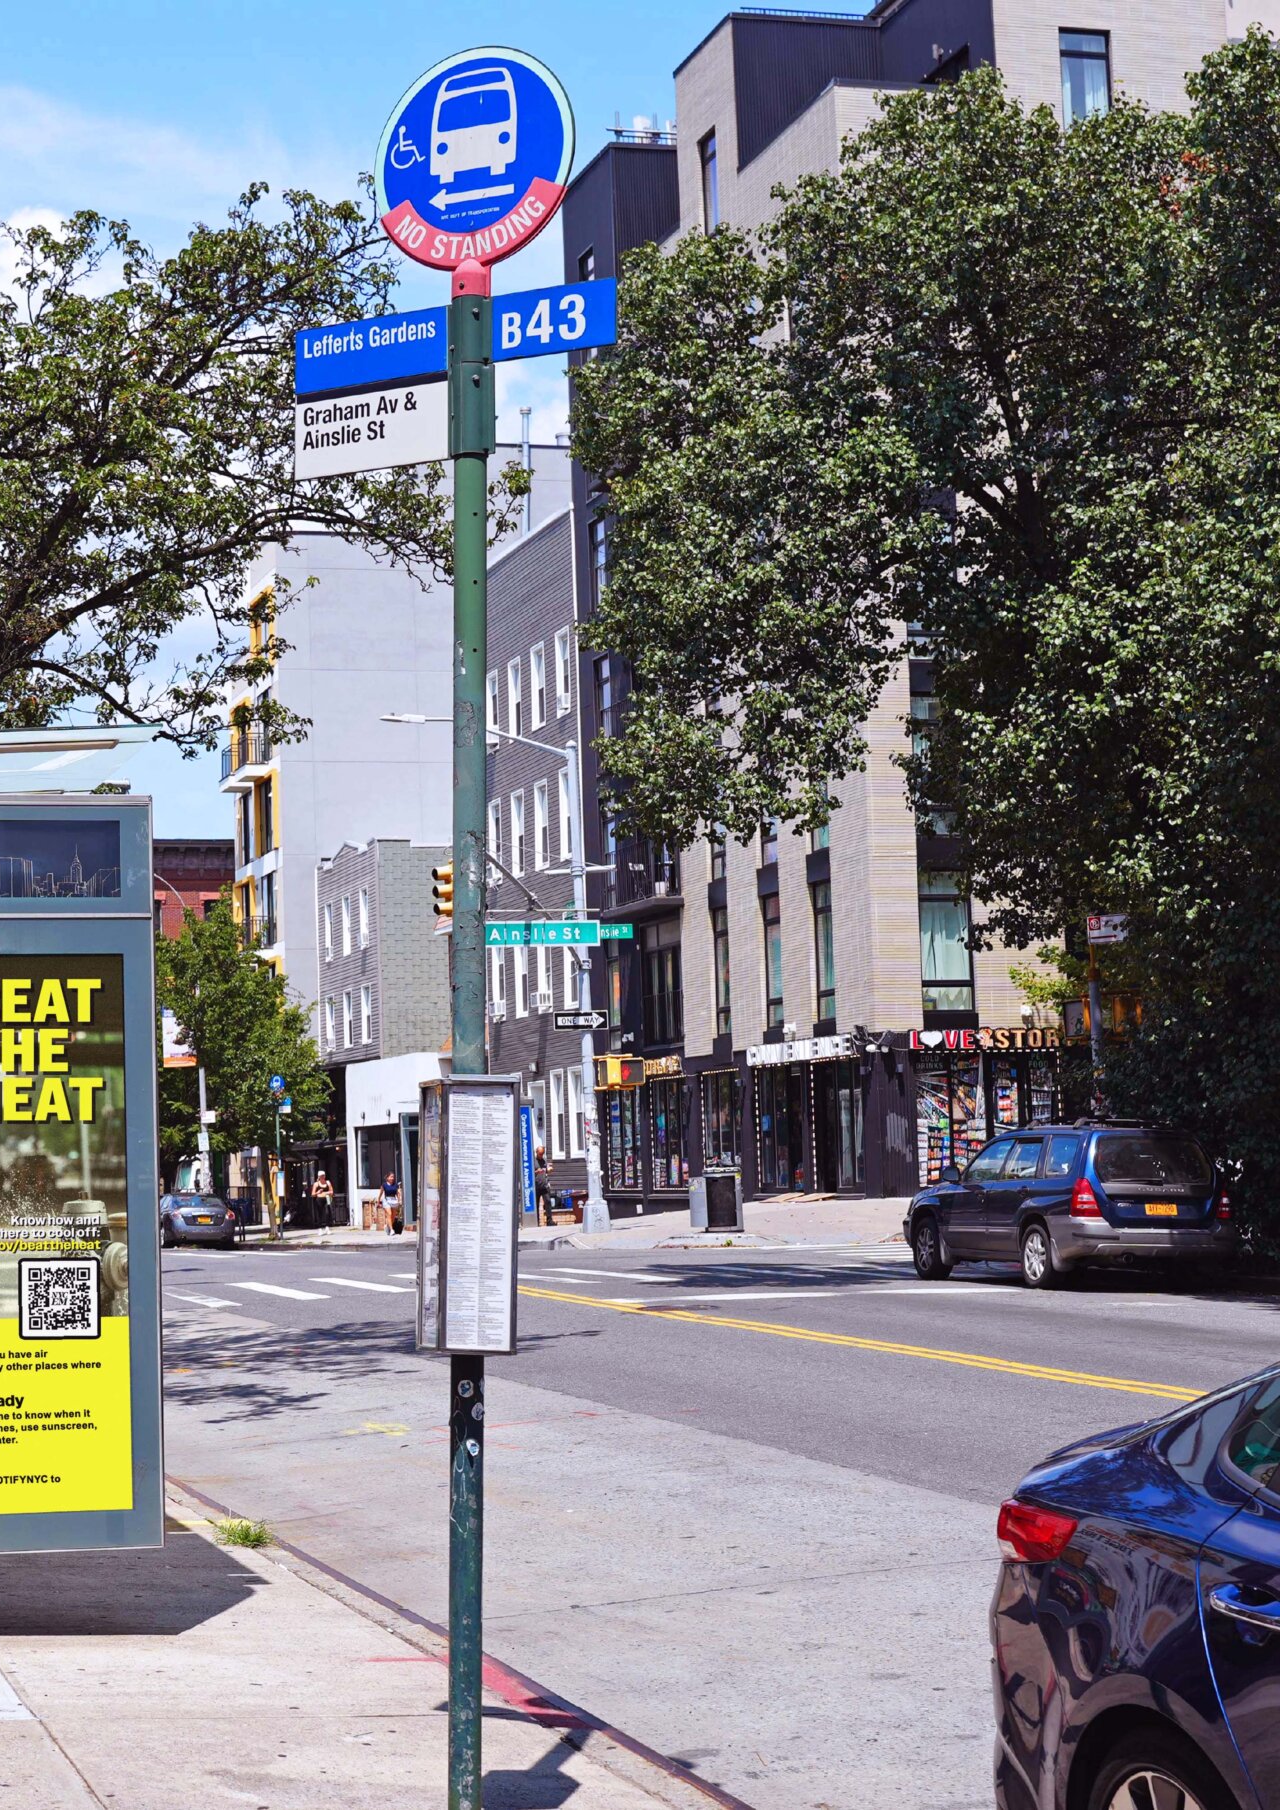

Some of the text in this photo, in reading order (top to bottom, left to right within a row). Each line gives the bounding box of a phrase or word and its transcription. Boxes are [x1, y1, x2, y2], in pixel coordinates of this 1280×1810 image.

[394, 196, 546, 259] NO STANDING
[501, 294, 587, 350] B43
[303, 319, 436, 359] Lefferts Gardens
[303, 391, 418, 427] Graham Av &
[302, 420, 386, 450] Ainslie St
[489, 928, 581, 941] Ainslie St
[561, 1015, 599, 1025] ONE WAY
[995, 1028, 1060, 1049] STOR
[746, 1034, 851, 1067] CONVENIENCE
[916, 1062, 944, 1070] DRINKS
[10, 1215, 101, 1226] Know how and
[32, 1229, 46, 1239] to
[49, 1228, 75, 1239] cool
[77, 1227, 101, 1238] off:
[51, 1291, 68, 1299] NYC
[51, 1298, 68, 1306] EM
[8, 1350, 32, 1359] have
[34, 1349, 48, 1358] air
[6, 1362, 33, 1371] other
[35, 1362, 68, 1372] places
[71, 1360, 101, 1369] where
[12, 1412, 22, 1420] to
[25, 1411, 52, 1419] know
[54, 1410, 81, 1418] when
[83, 1409, 90, 1417] it
[21, 1424, 39, 1432] use
[41, 1422, 97, 1431] sunscreen,
[50, 1475, 61, 1483] to
